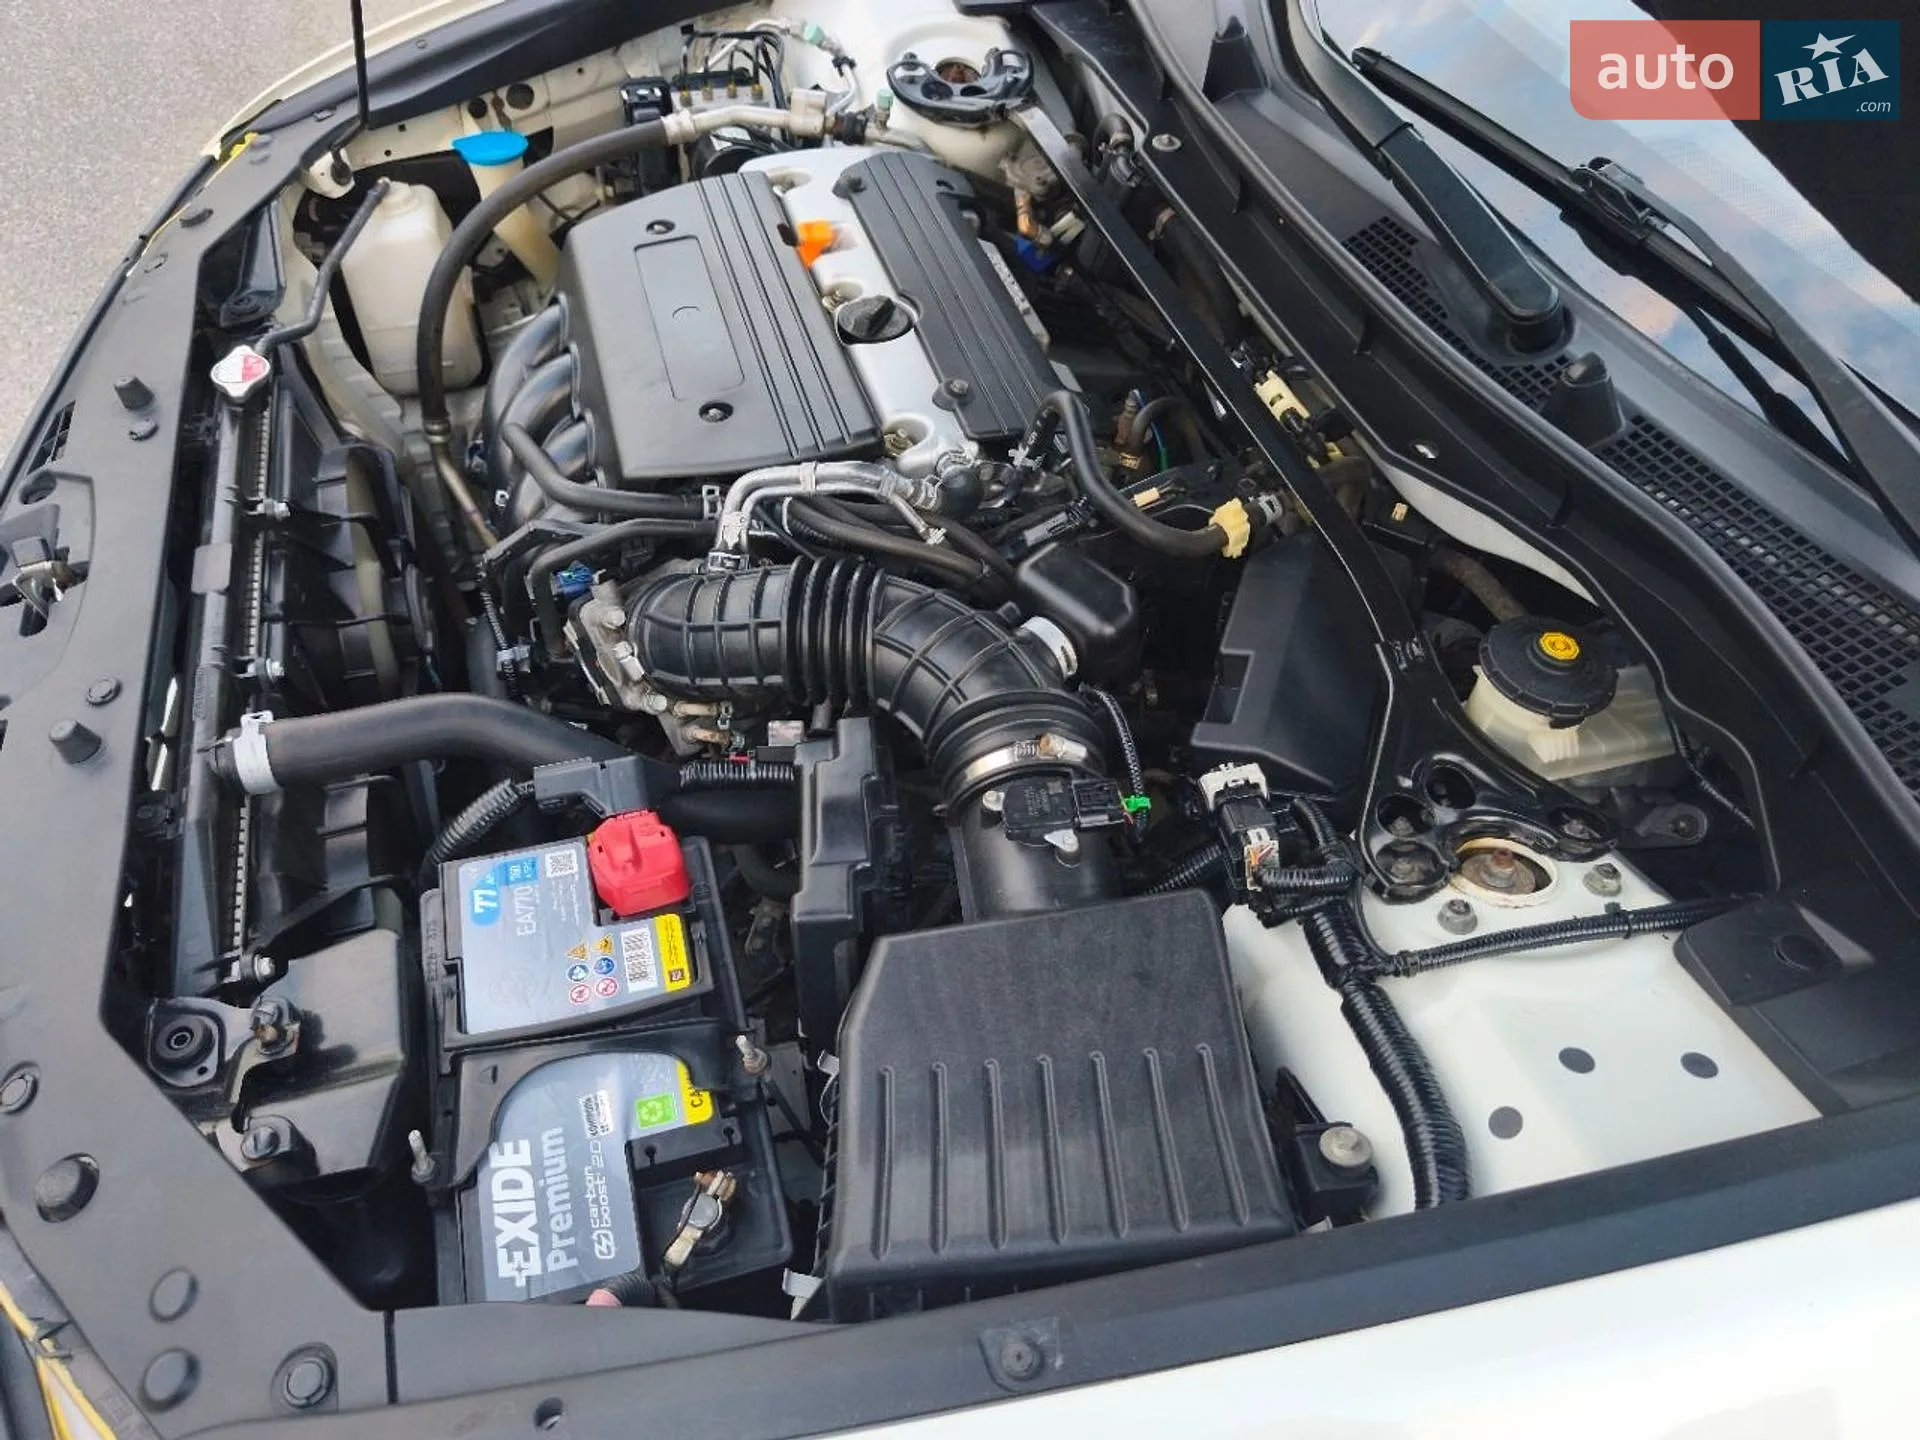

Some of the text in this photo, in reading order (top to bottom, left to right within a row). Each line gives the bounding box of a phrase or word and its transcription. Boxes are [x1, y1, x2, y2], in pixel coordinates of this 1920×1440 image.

[473, 889, 498, 913] 77
[514, 885, 537, 936] EA770
[488, 1138, 543, 1287] EXIDE
[538, 1126, 579, 1272] Premium
[584, 1165, 600, 1229] carbon
[593, 1175, 612, 1229] boost
